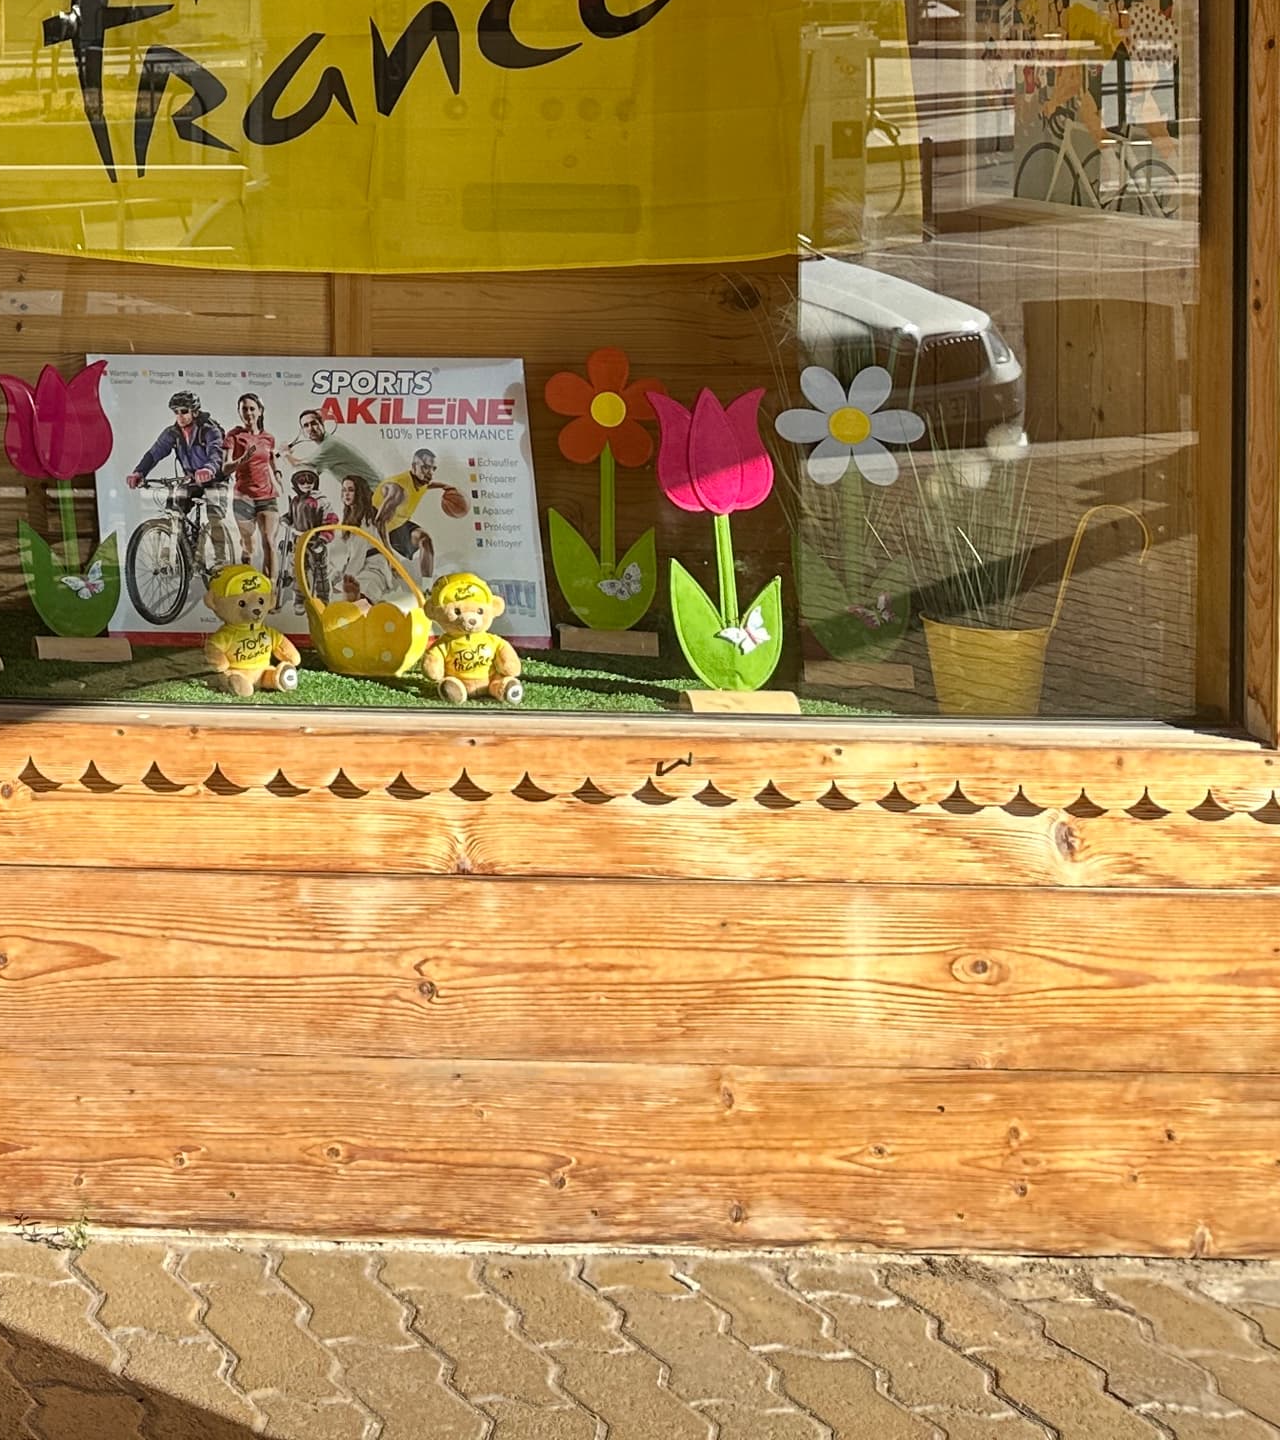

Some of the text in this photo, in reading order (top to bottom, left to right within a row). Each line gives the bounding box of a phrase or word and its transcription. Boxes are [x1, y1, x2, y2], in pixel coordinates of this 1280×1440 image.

[311, 369, 433, 396] SPORTS
[379, 427, 515, 441] 100% PERFORMANCE
